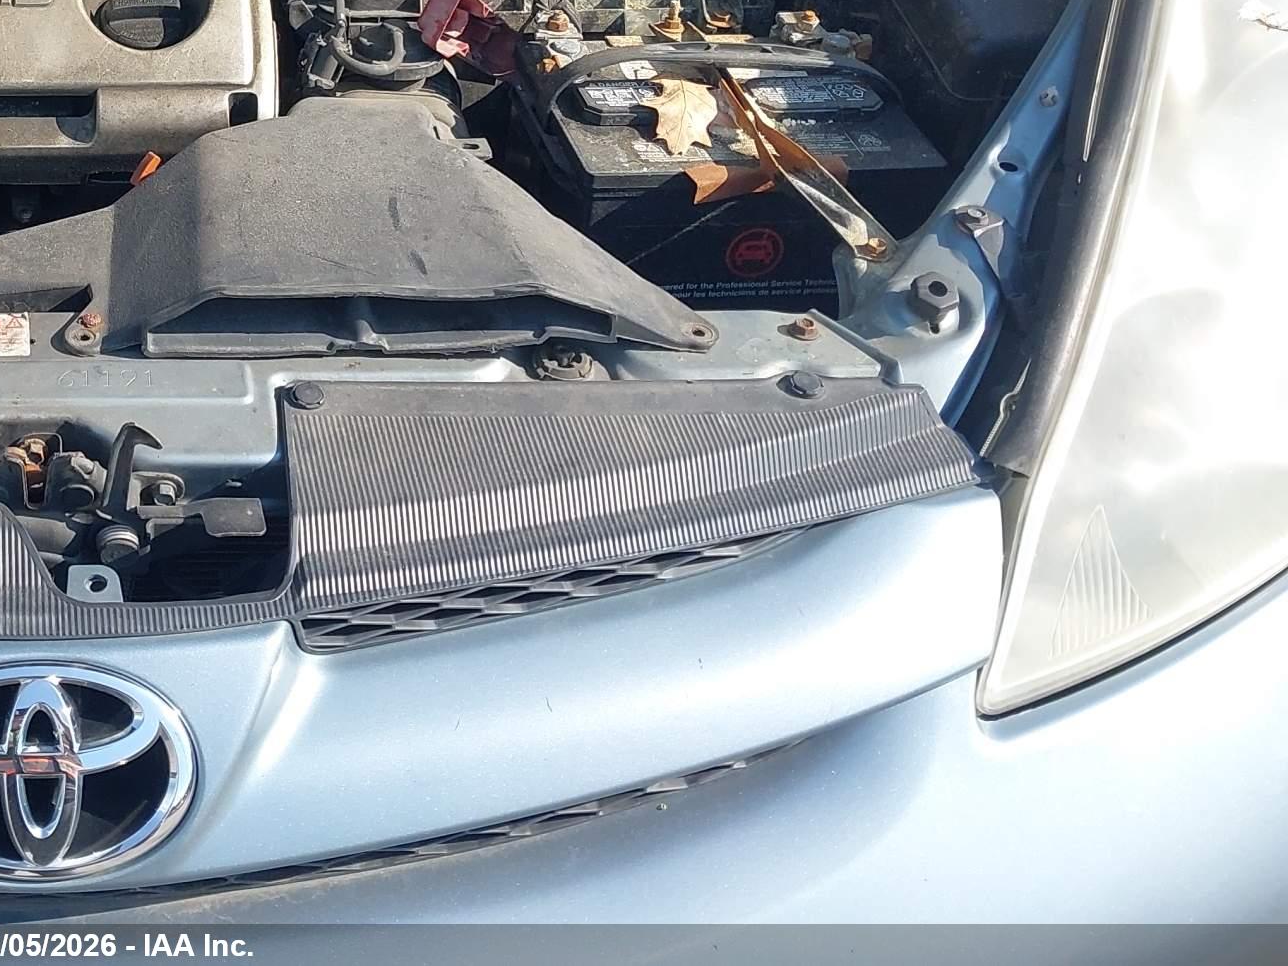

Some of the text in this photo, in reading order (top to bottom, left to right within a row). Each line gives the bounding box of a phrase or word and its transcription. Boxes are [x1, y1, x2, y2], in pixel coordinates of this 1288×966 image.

[686, 282, 699, 290] for
[700, 281, 714, 290] the
[716, 280, 768, 290] Professional
[804, 278, 837, 286] Technic
